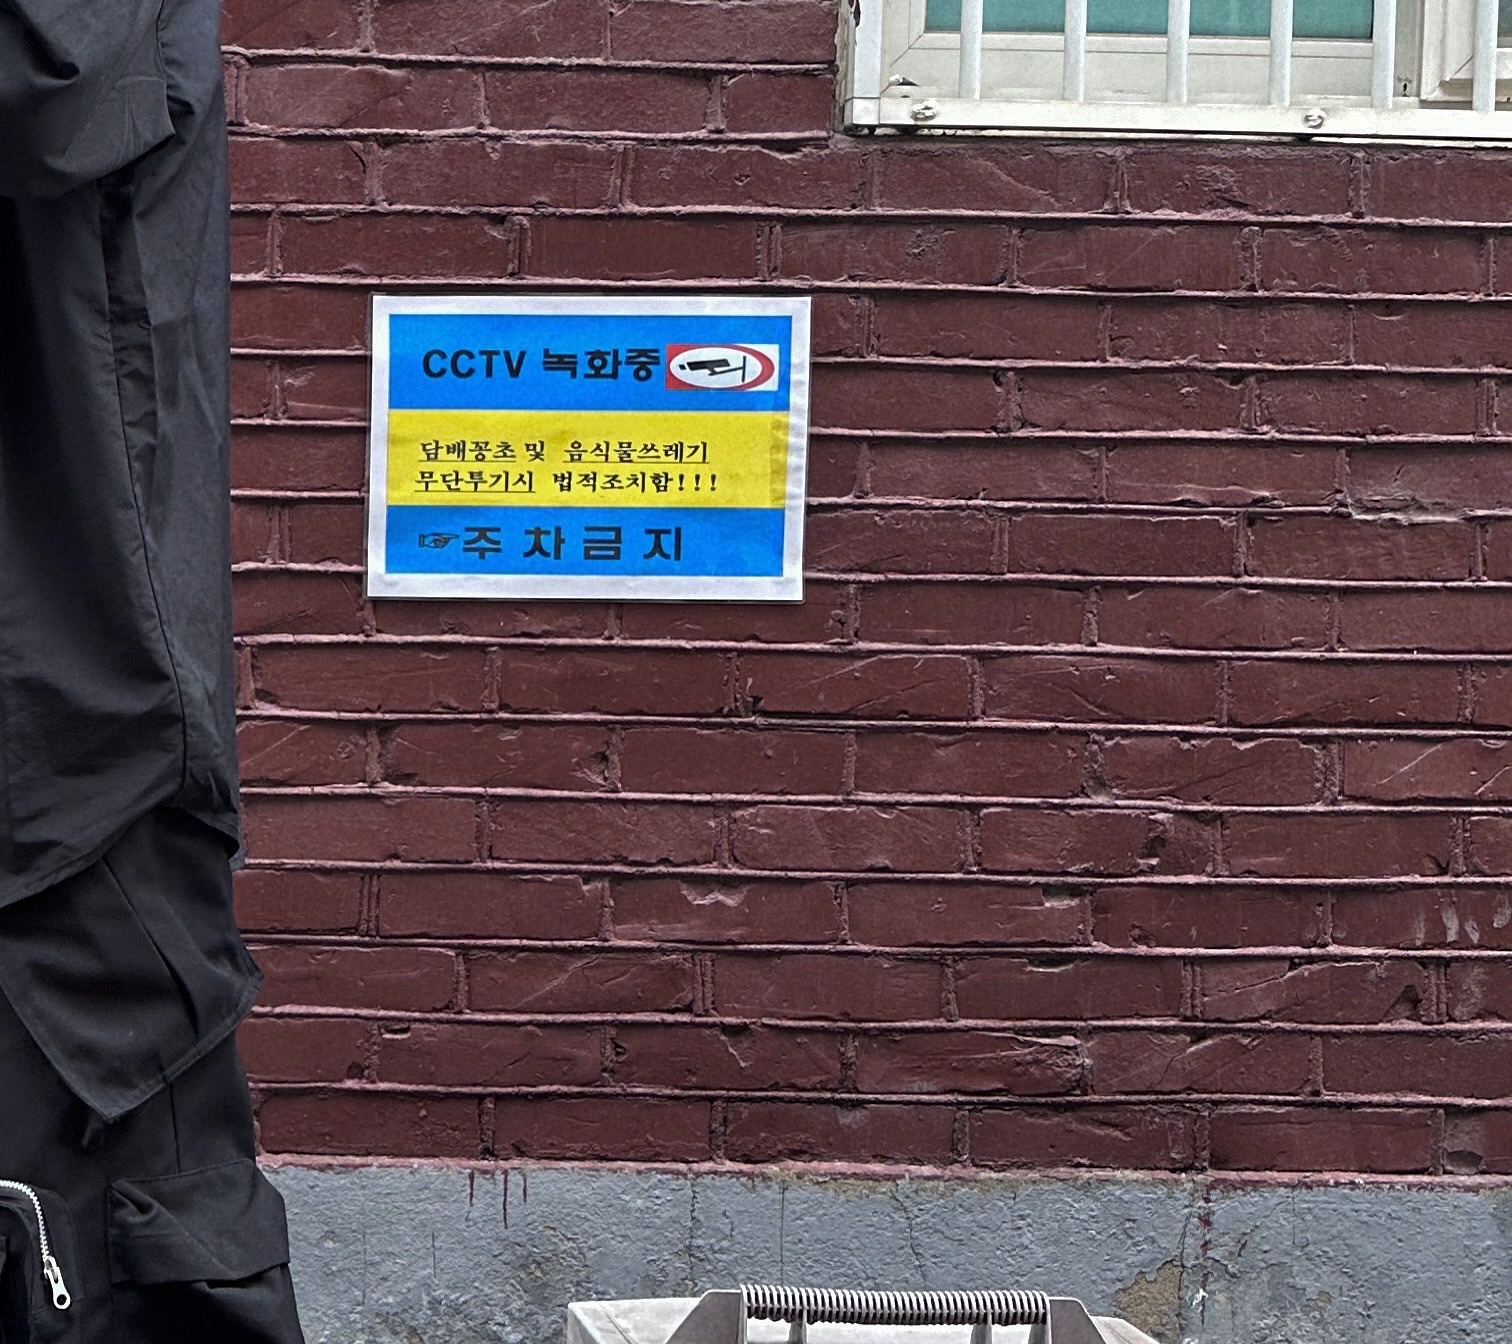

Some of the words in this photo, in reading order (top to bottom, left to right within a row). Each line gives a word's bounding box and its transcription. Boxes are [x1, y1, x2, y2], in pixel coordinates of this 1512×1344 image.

[422, 348, 527, 379] CCTV
[541, 347, 661, 382] 녹화중
[419, 439, 516, 462] 담배꽁초
[524, 440, 545, 462] 및
[563, 440, 709, 463] 음식물쓰레기
[414, 470, 535, 493] 무단투기시
[553, 471, 717, 493] 법적조치함!!!
